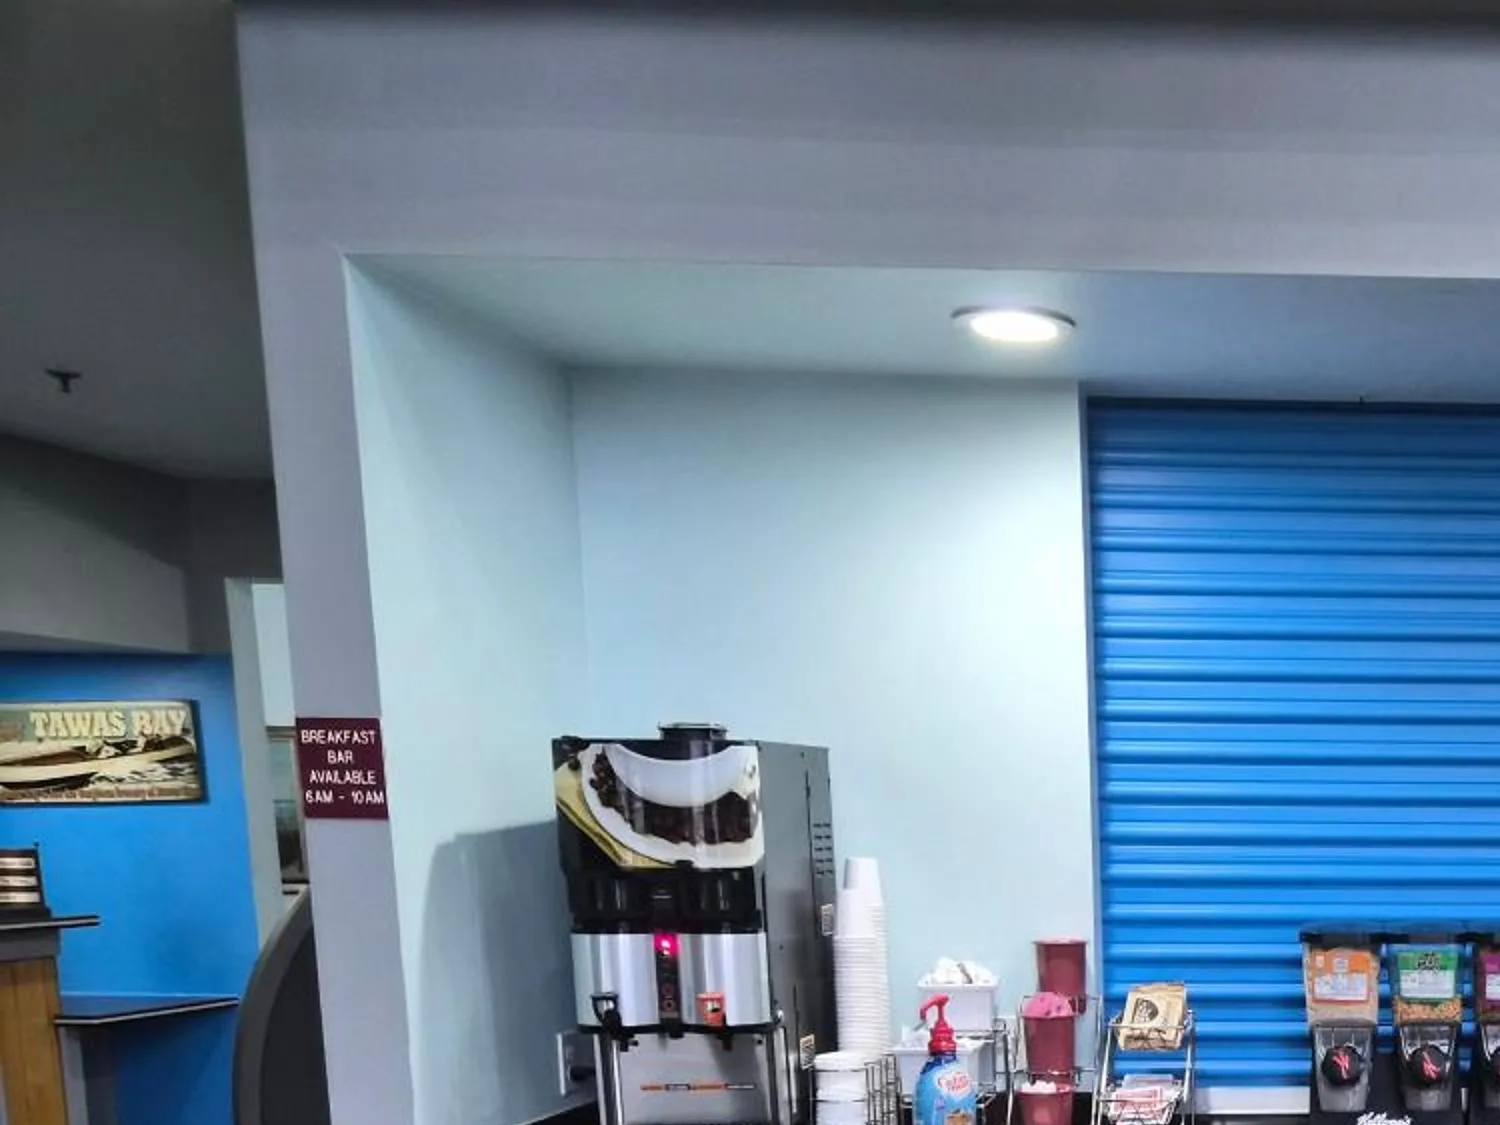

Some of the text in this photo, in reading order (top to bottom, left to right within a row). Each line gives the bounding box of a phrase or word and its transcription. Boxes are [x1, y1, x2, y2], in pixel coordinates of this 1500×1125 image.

[29, 710, 127, 738] TAWAS
[301, 729, 376, 745] BREAKFAST
[327, 749, 355, 765] BAR
[309, 769, 377, 785] AVAILABLE
